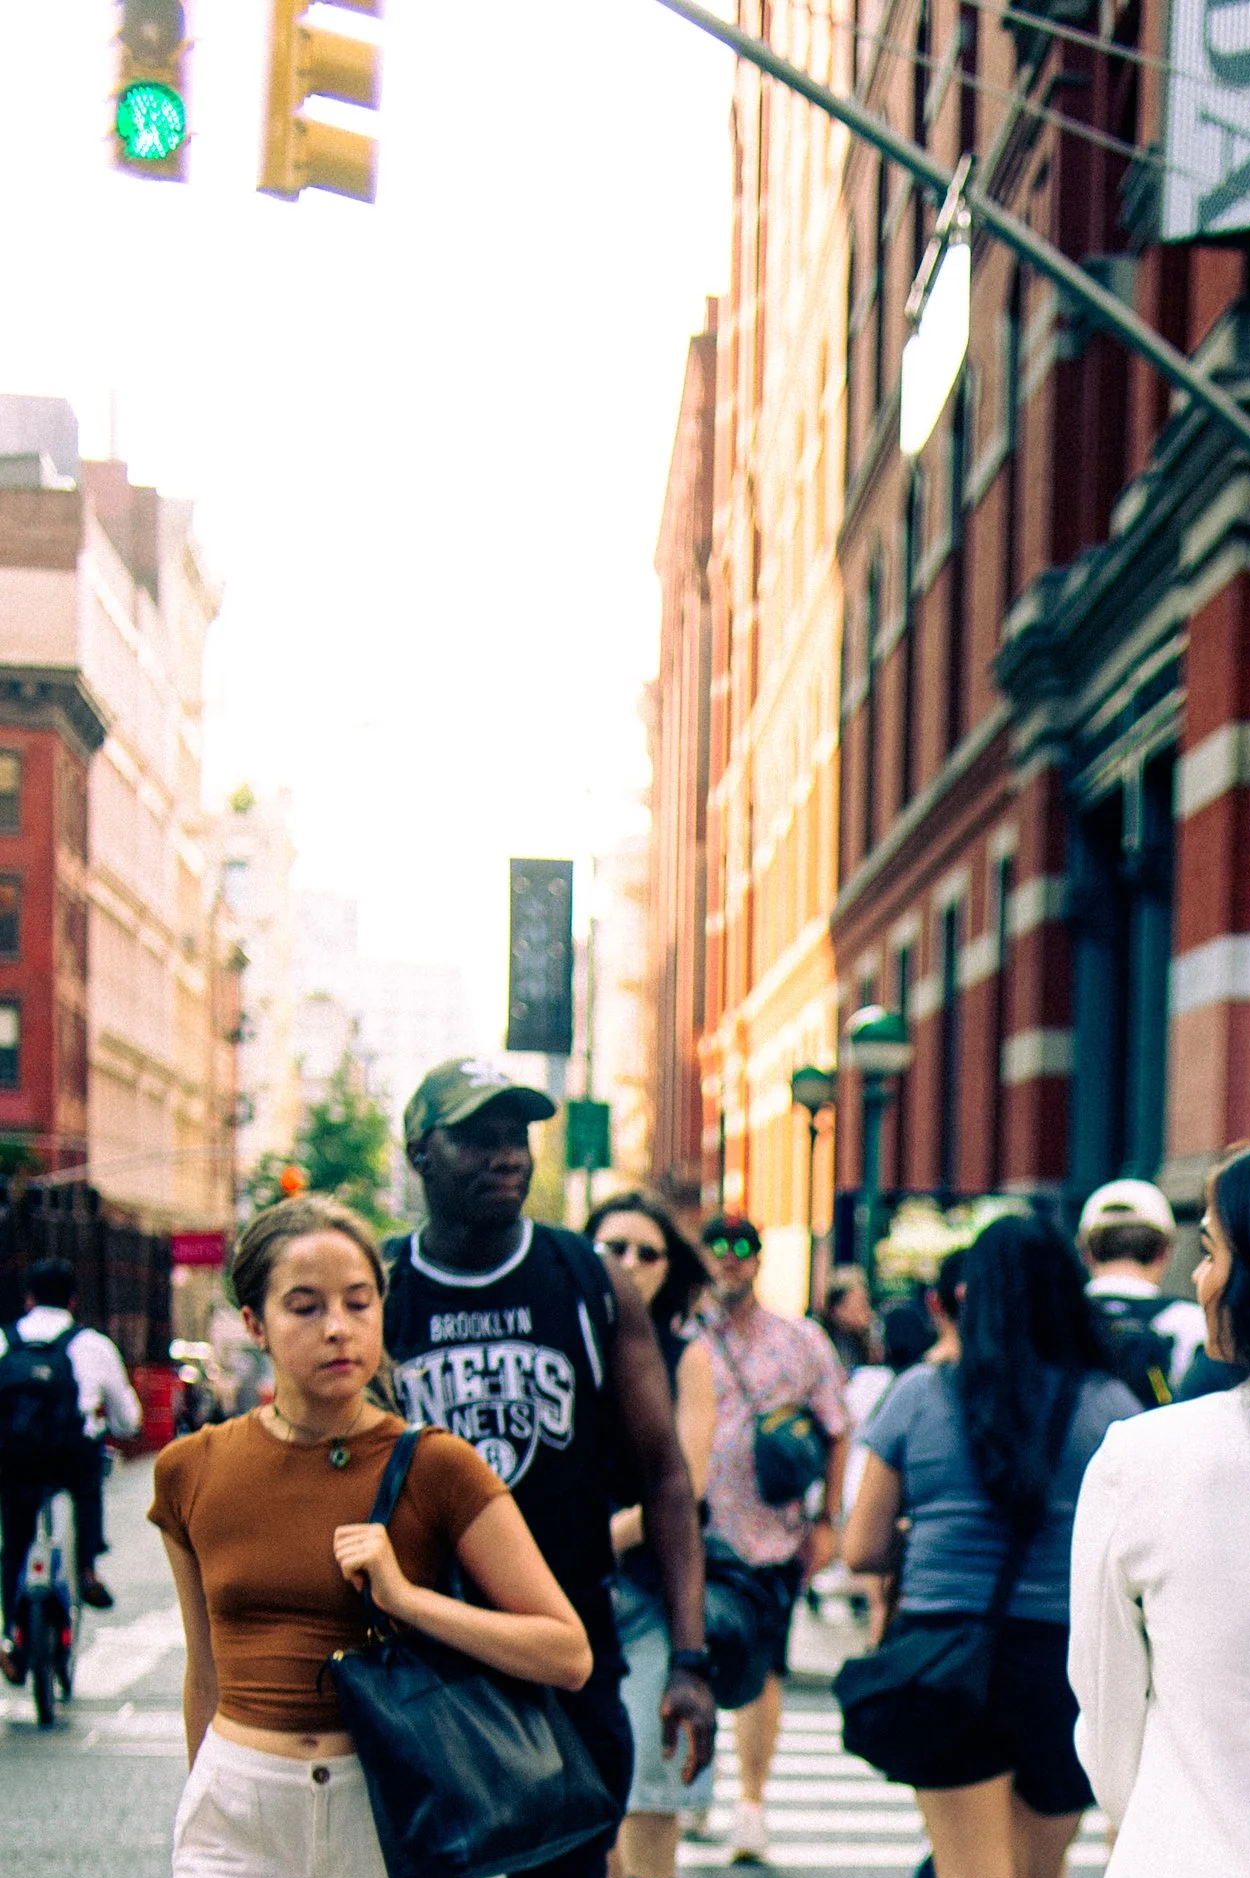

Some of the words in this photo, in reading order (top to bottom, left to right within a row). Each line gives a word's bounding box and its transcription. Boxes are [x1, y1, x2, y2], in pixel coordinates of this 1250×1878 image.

[430, 1305, 533, 1343] BROOKLYN
[395, 1340, 575, 1448] NETS
[451, 1401, 534, 1440] NETS
